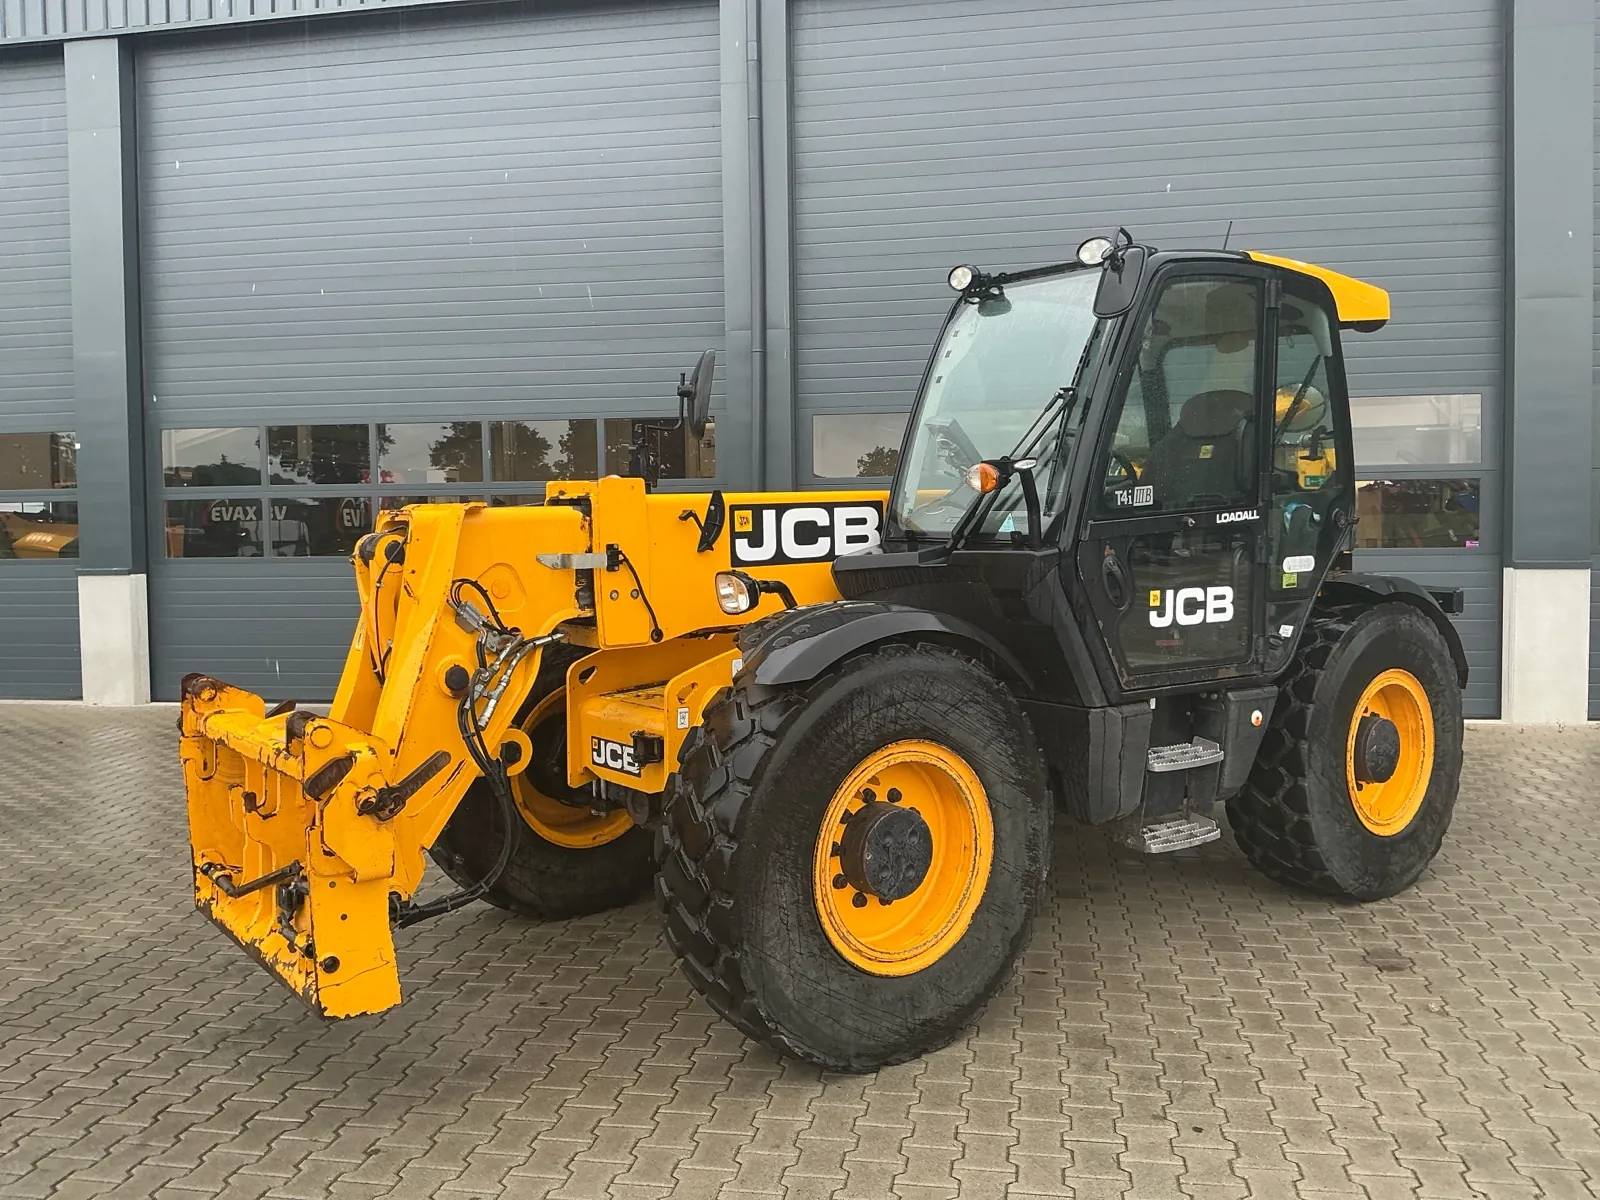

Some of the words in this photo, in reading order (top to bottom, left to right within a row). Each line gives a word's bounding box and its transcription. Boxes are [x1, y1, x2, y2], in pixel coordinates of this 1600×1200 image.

[211, 506, 257, 522] EVAX
[1216, 510, 1260, 524] LOADALL
[735, 506, 881, 562] JCB
[1149, 585, 1234, 628] JCB
